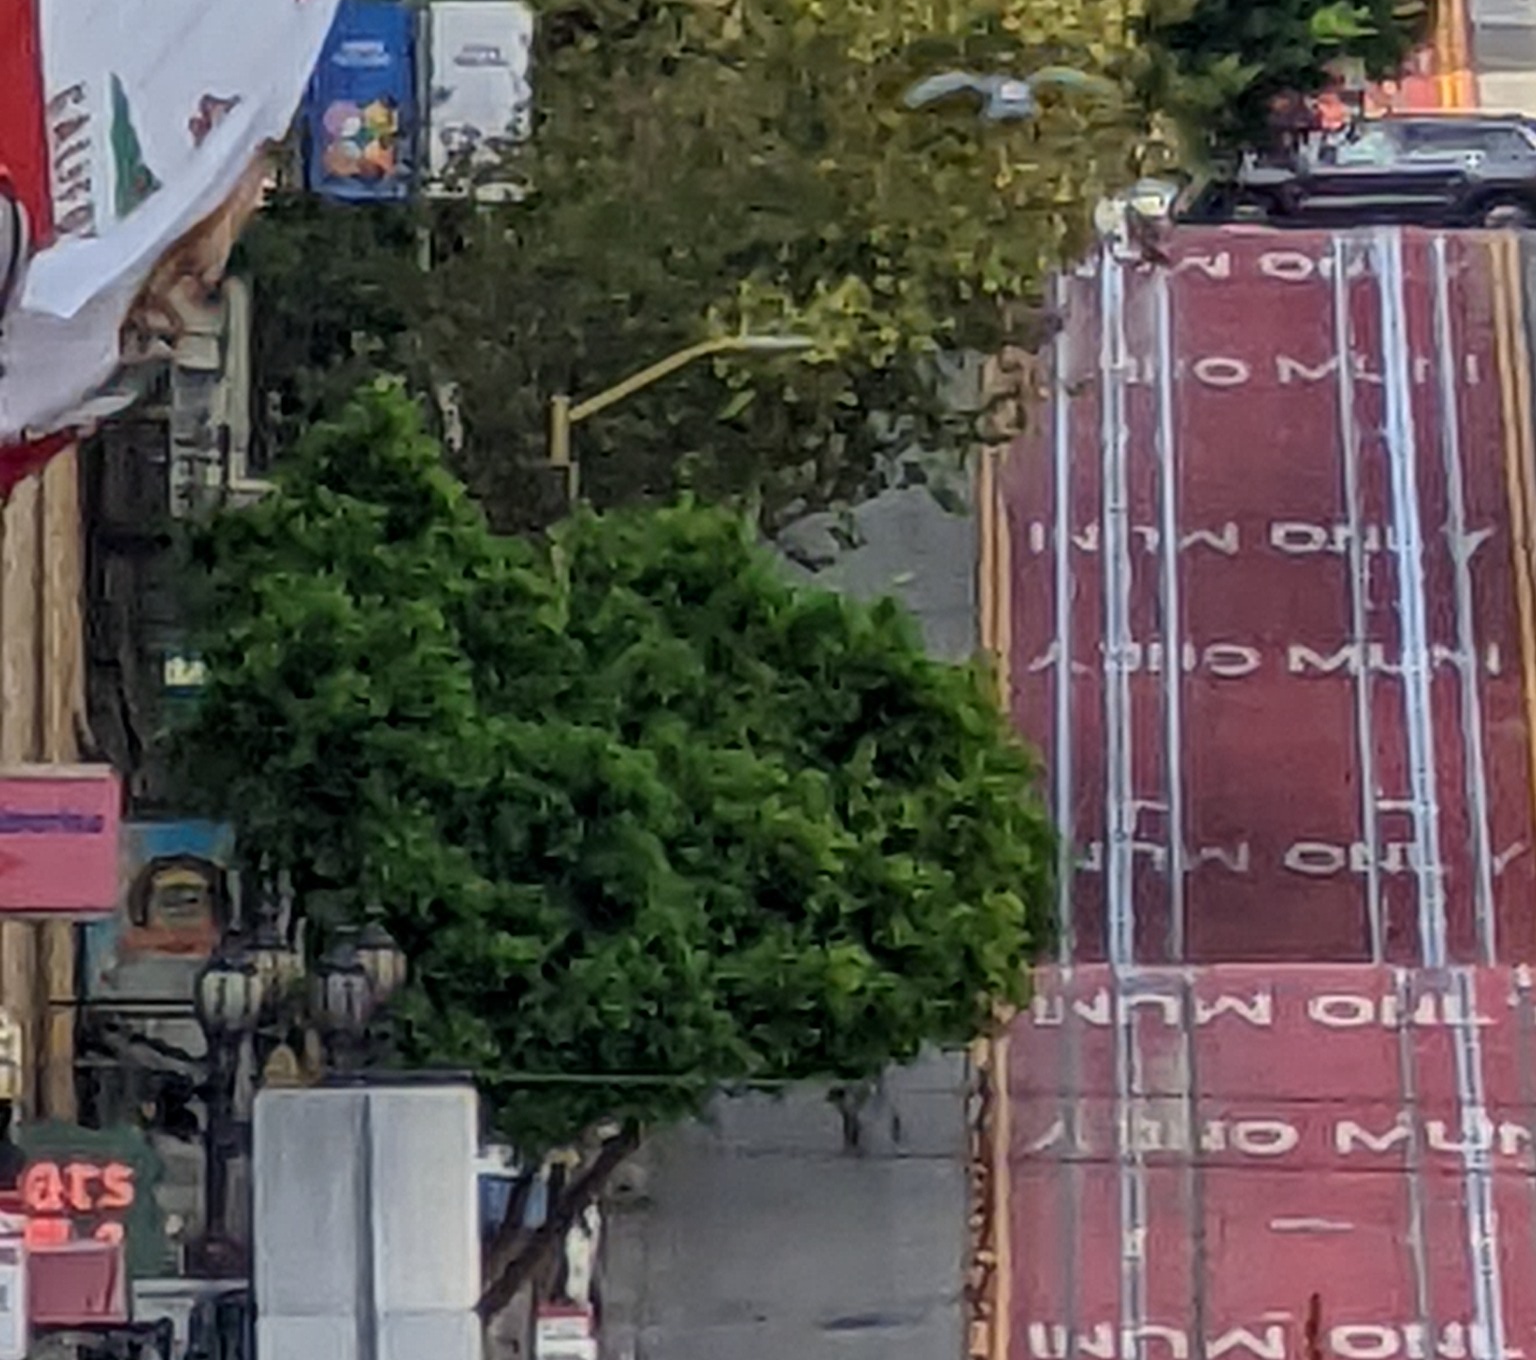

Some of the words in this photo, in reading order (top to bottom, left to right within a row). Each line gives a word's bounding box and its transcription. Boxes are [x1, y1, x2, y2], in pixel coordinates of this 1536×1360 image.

[50, 82, 98, 238] CALIFO
[1073, 840, 1249, 872] MUN
[1032, 992, 1273, 1027] MUNI
[1028, 1118, 1299, 1154] ONLY
